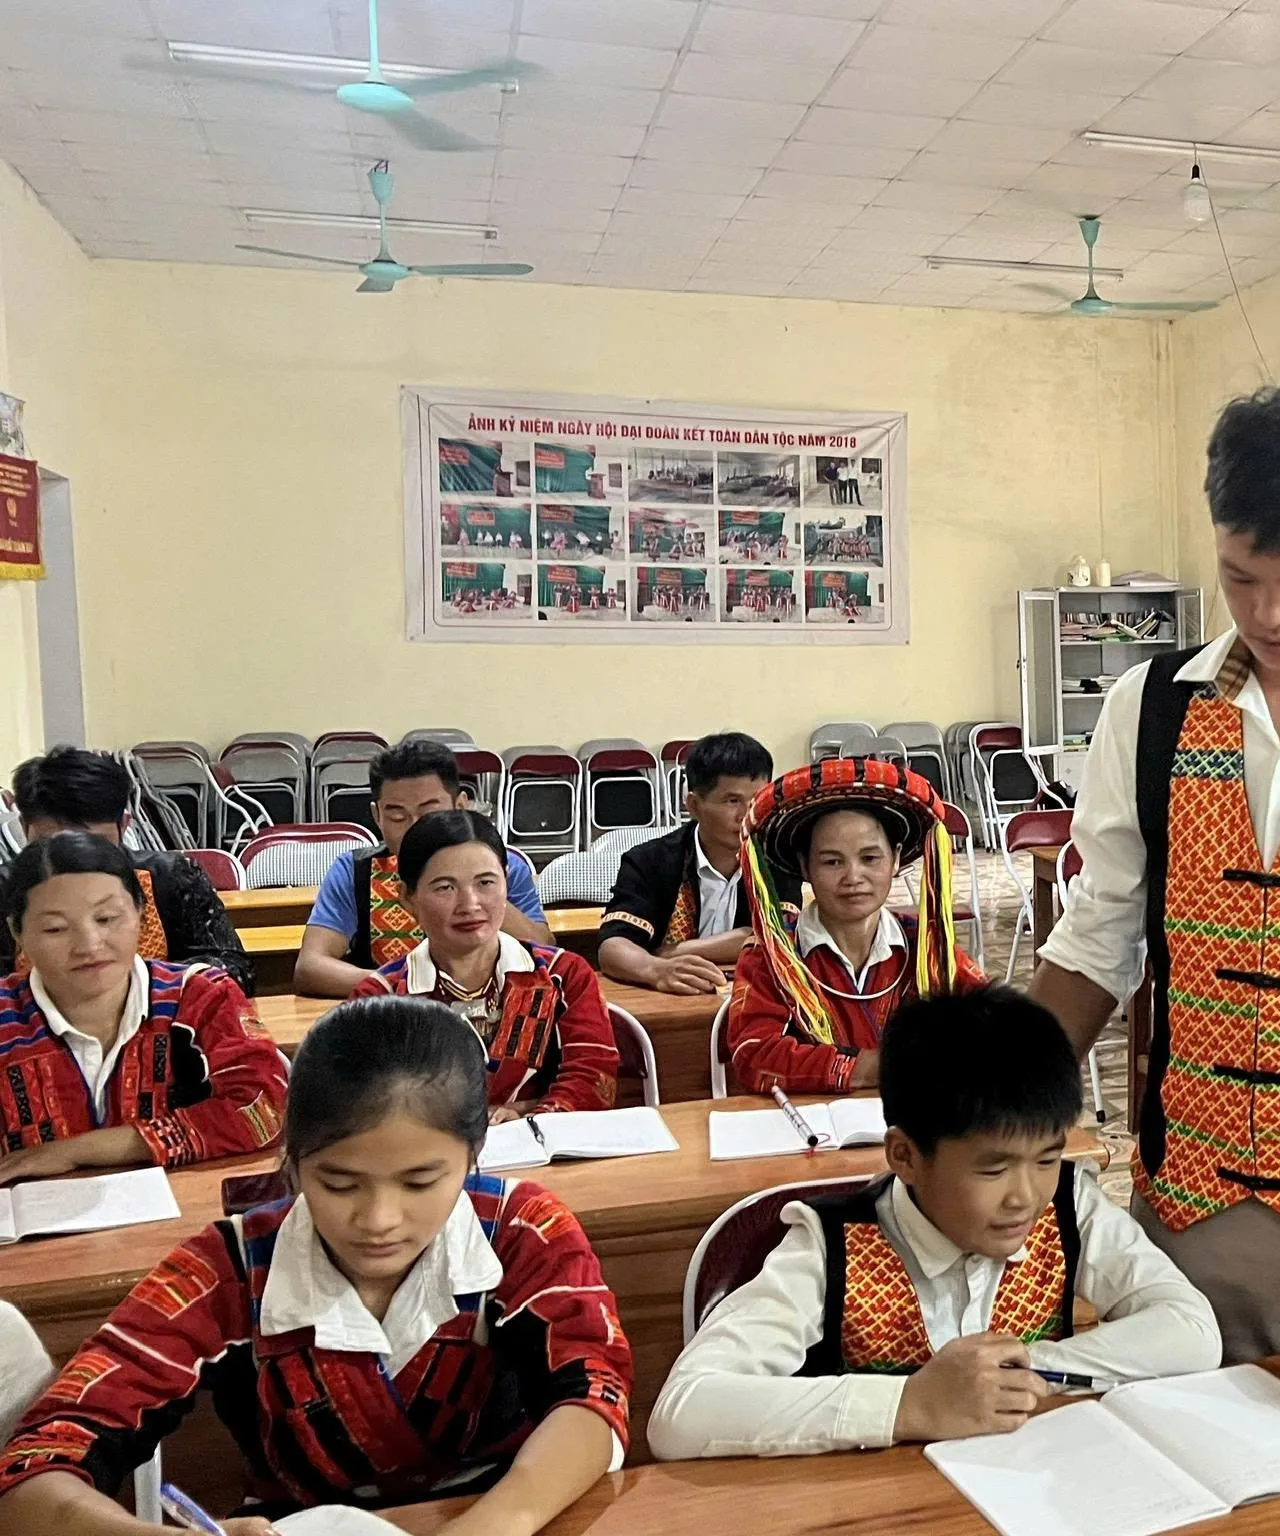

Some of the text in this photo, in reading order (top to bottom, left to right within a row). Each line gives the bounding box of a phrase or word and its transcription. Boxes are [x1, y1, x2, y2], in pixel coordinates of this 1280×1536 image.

[468, 412, 495, 431] ẢNH
[520, 418, 554, 436] NIỆM
[558, 420, 592, 435] NGÀY
[596, 421, 617, 439] HỘI
[744, 428, 769, 444] DÂN
[772, 431, 795, 447] TỘC
[829, 436, 857, 448] 2018
